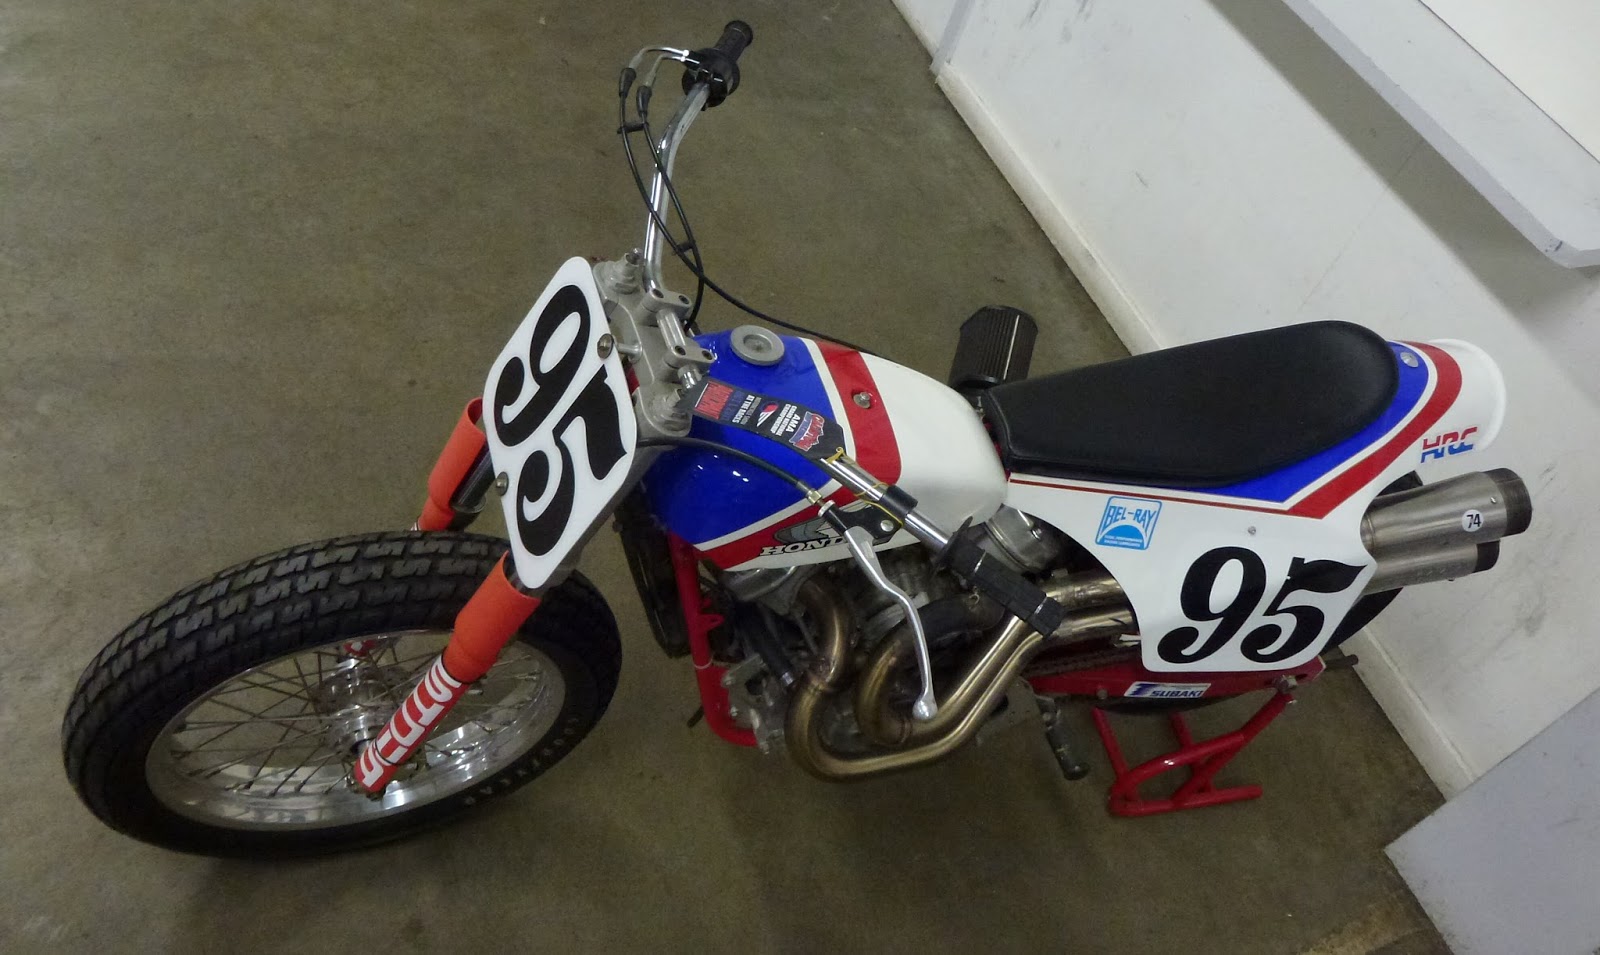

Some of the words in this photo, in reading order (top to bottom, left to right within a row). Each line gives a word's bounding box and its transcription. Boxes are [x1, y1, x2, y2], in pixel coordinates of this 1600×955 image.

[493, 284, 628, 556] 95
[785, 413, 801, 432] AMA
[1420, 426, 1478, 463] HRC
[1100, 505, 1157, 537] BEL-RAY
[1466, 513, 1482, 529] 74
[759, 536, 848, 556] HOND
[1157, 546, 1367, 664] 95
